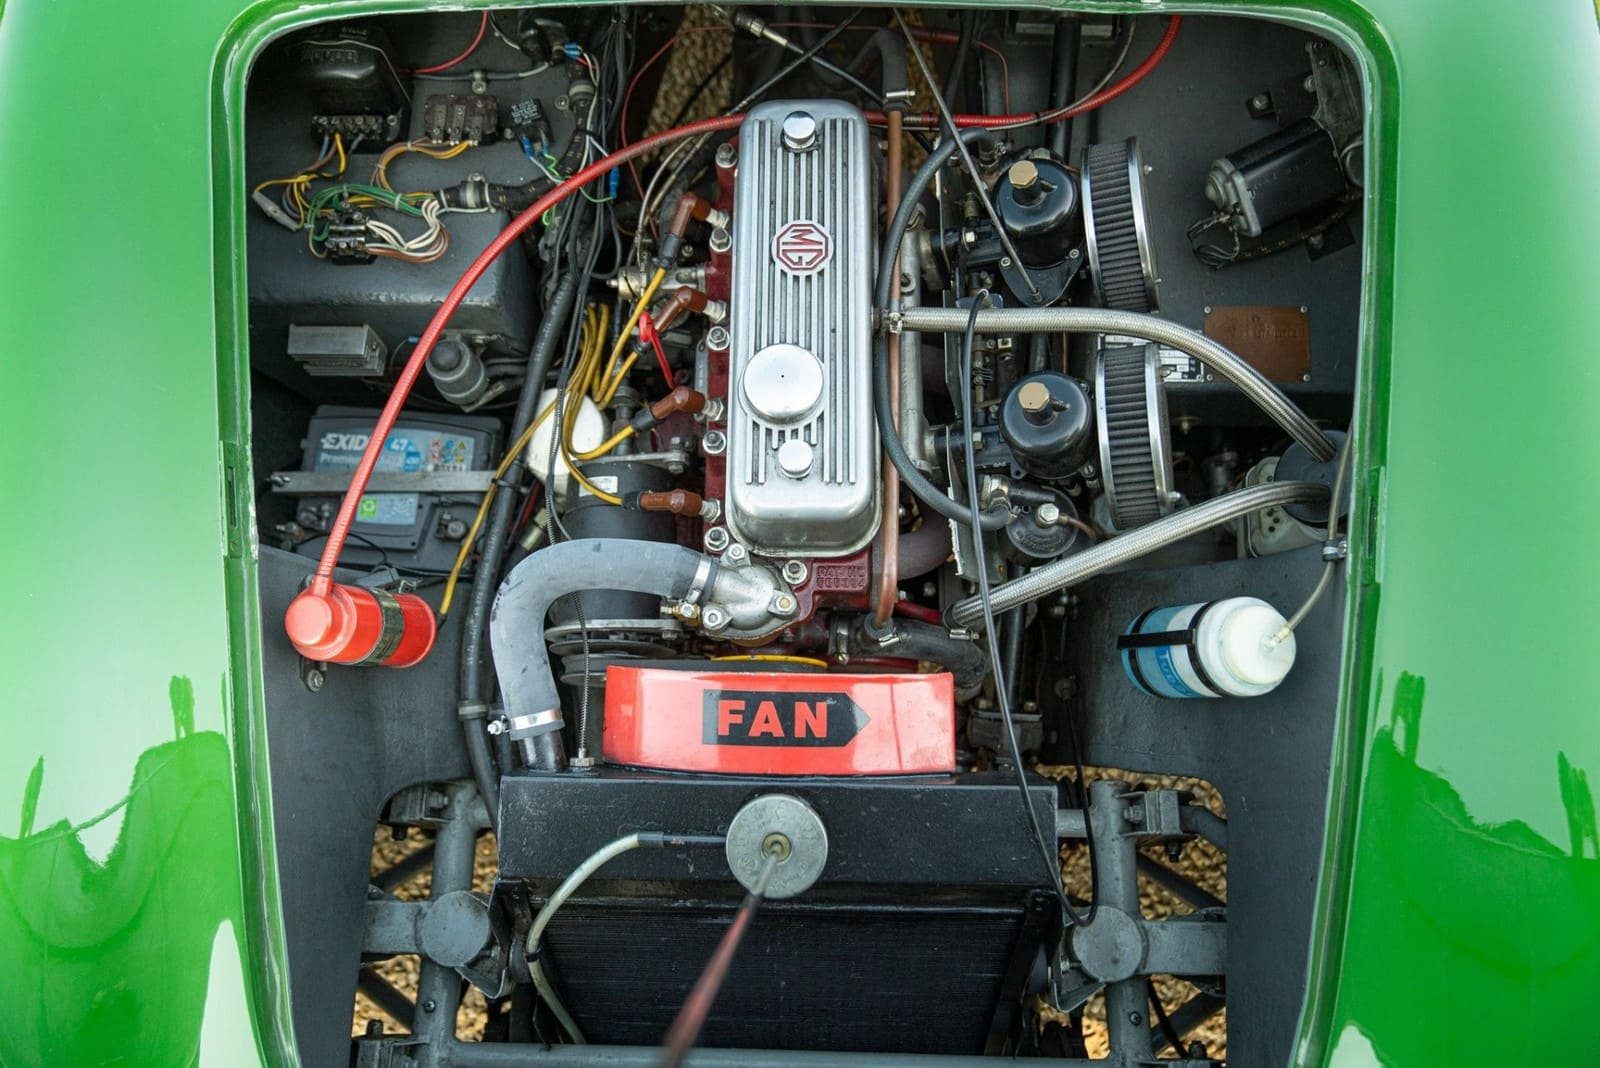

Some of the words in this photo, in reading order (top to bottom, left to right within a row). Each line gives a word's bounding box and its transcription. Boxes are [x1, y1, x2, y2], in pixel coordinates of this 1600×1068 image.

[781, 228, 824, 267] MG
[320, 433, 369, 451] EXID
[390, 438, 409, 451] 47
[717, 699, 828, 739] FAN
